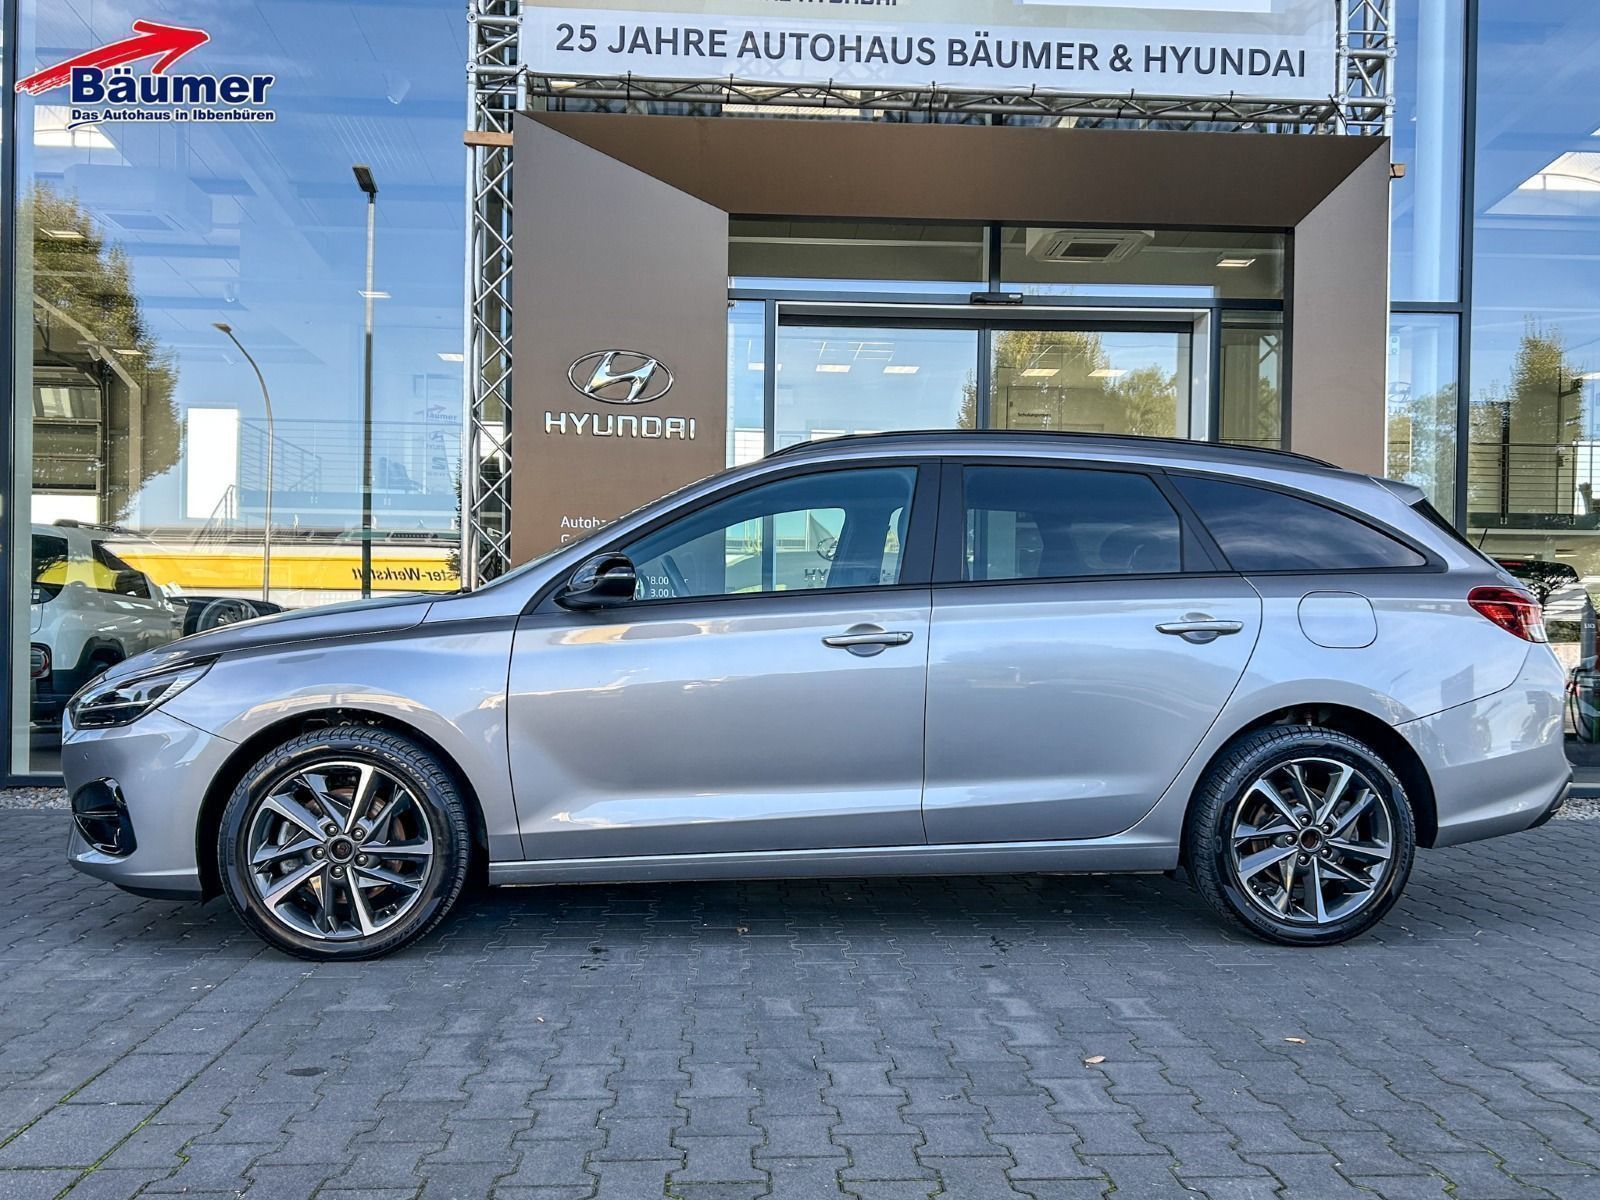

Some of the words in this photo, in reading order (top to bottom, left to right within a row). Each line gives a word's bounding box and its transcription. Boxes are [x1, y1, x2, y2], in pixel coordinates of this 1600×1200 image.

[555, 22, 598, 52] 25
[607, 25, 728, 58] JAHRE
[736, 30, 936, 66] AUTOHAUS
[947, 31, 1101, 71] BÄUMER
[1108, 43, 1134, 72] &
[1143, 44, 1306, 78] HYUNDAI
[545, 411, 696, 440] HYUNDAI
